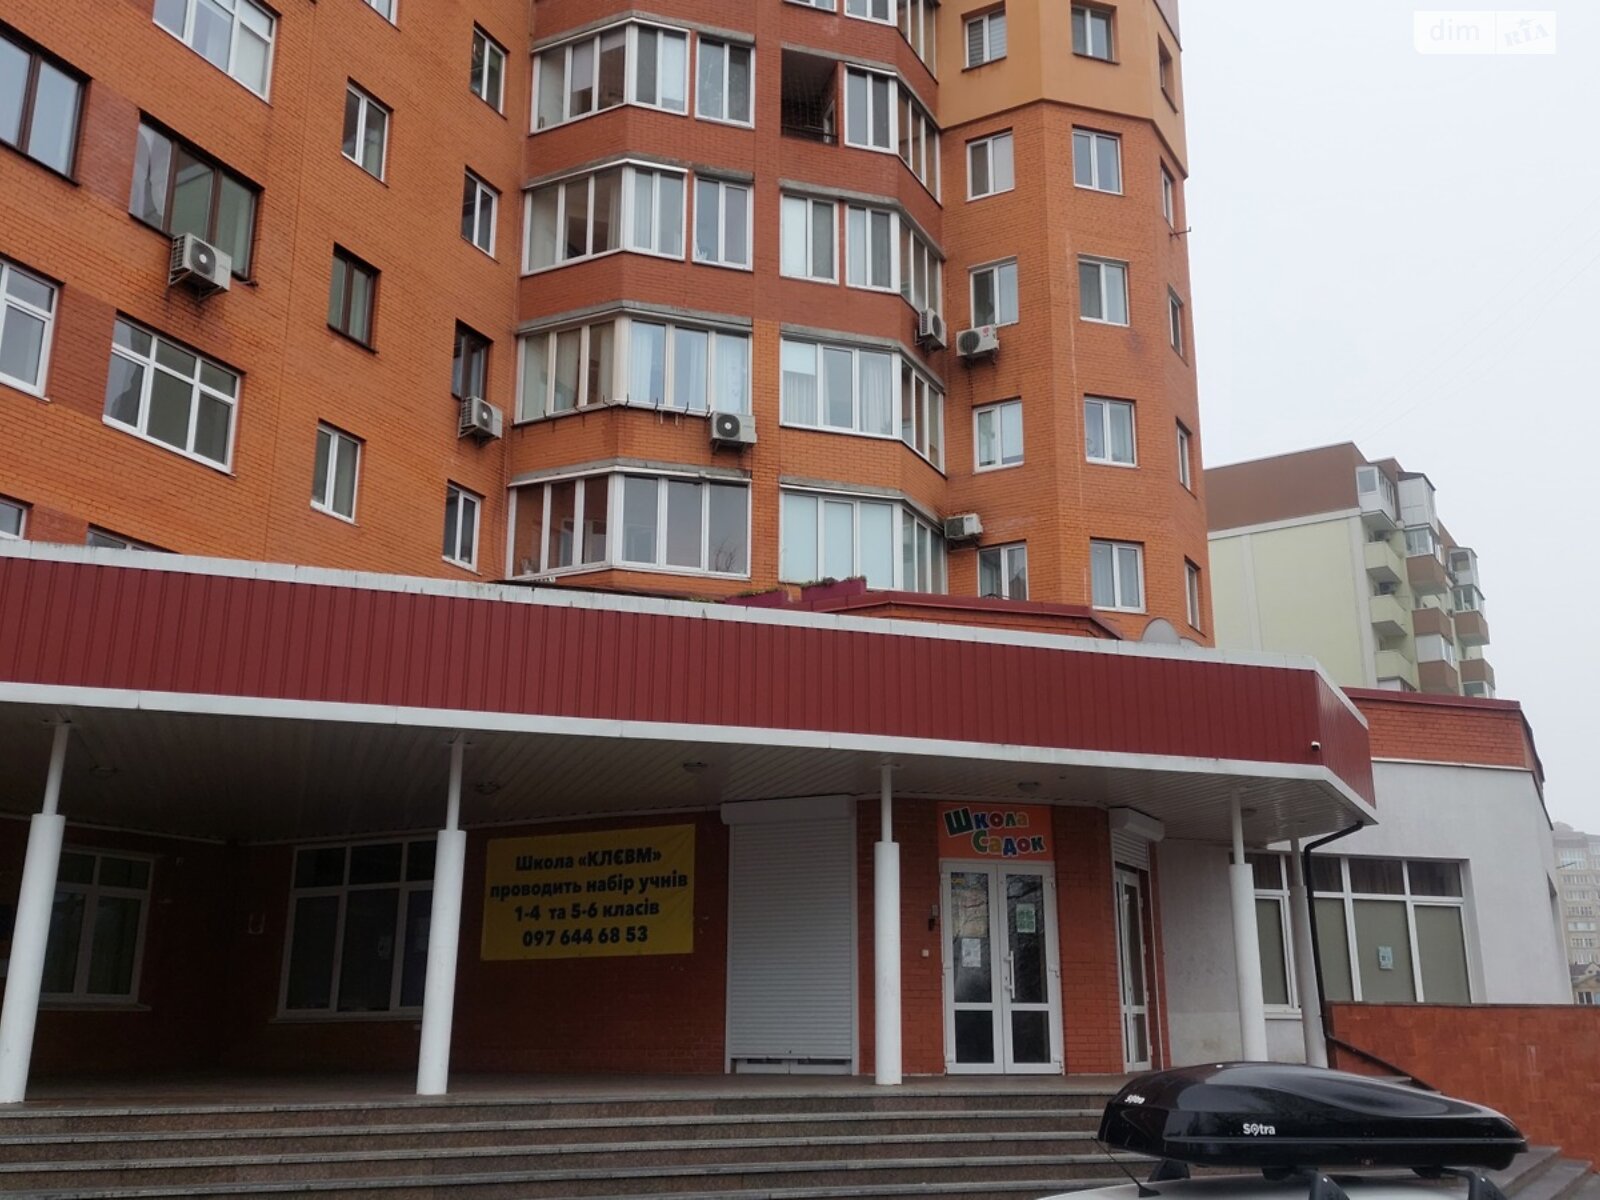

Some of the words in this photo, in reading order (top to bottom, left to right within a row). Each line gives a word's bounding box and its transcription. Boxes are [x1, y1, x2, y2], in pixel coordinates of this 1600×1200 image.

[944, 806, 1029, 837] Школа
[971, 830, 1046, 857] Садок
[515, 855, 574, 871] Школа
[578, 847, 662, 867] «КЛЄВМ»
[490, 881, 582, 900] проводить
[586, 874, 634, 894] набір
[638, 870, 688, 893] учнів
[514, 905, 541, 921] 1-4
[548, 907, 566, 920] та
[571, 902, 597, 919] 5-6
[603, 898, 660, 918] класів
[522, 929, 556, 947] 097
[560, 928, 594, 945] 644
[598, 926, 620, 944] 68
[626, 925, 649, 942] 53
[1242, 1123, 1276, 1136] Sotra
